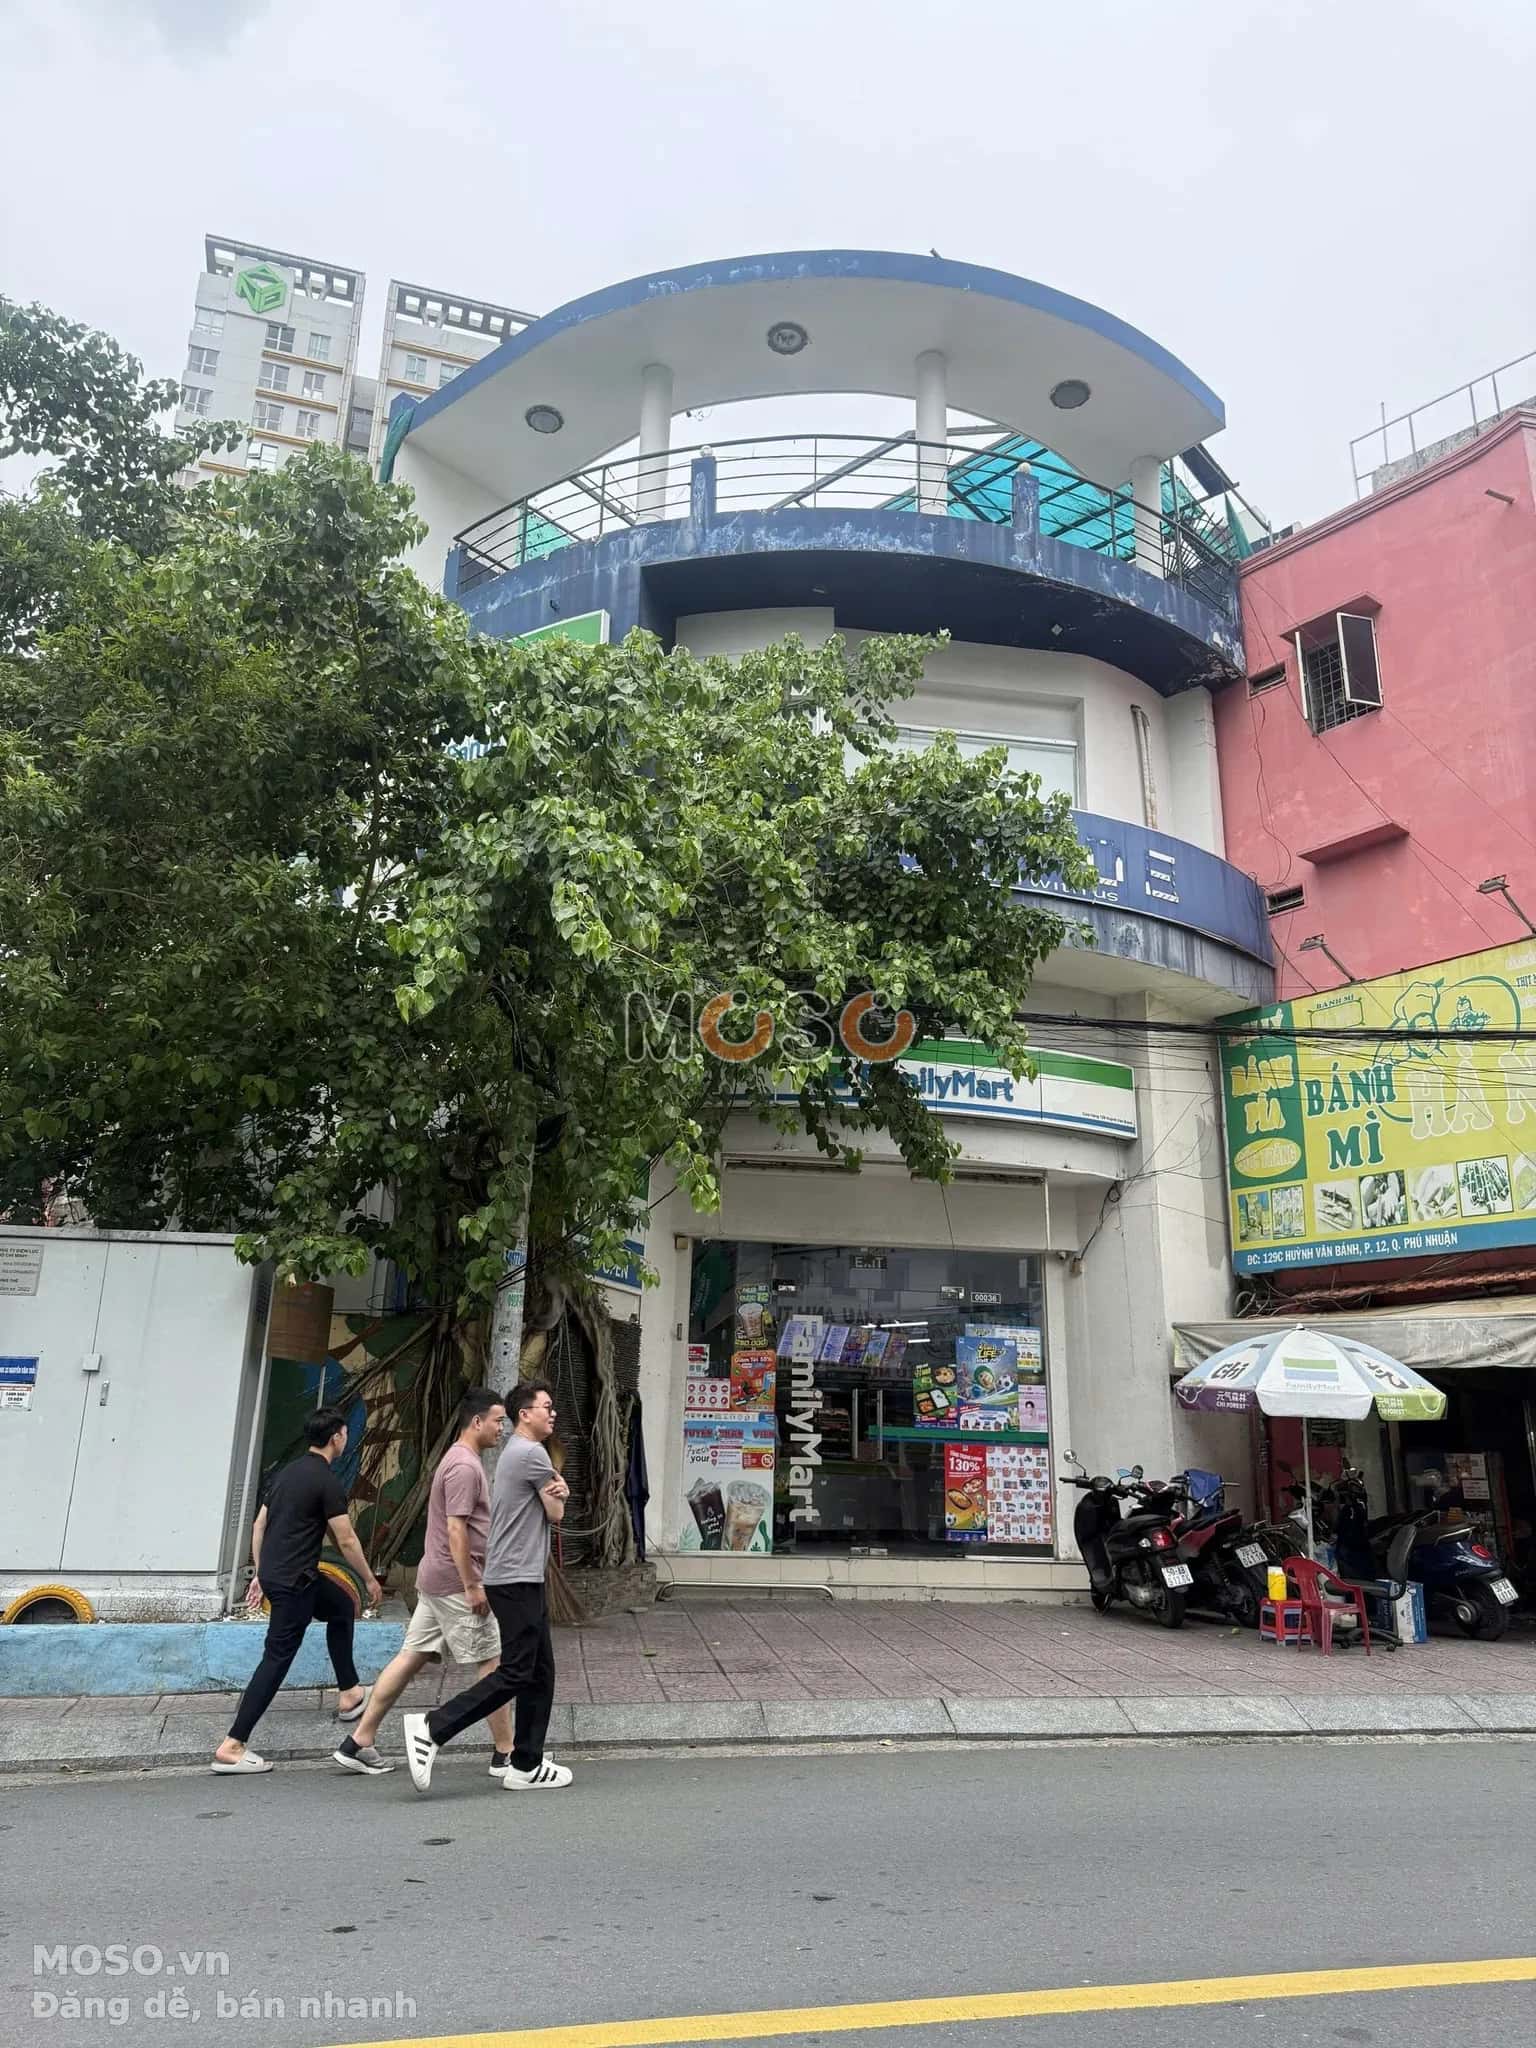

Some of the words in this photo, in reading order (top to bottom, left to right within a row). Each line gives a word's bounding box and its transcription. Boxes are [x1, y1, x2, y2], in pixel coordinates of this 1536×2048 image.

[1096, 886, 1119, 903] us
[1304, 1061, 1397, 1118] BÁNH
[1326, 1110, 1384, 1171] MÌ
[1335, 1243, 1362, 1256] BÁNH,
[1364, 1242, 1374, 1254] P.
[1376, 1241, 1390, 1254] 12,
[1391, 1240, 1401, 1252] Q.
[1404, 1237, 1423, 1249] PHÚ
[1425, 1232, 1458, 1248] NHUẬN
[603, 1261, 629, 1279] OEN
[785, 1314, 823, 1523] FamilyMart
[949, 1457, 980, 1472] 130%
